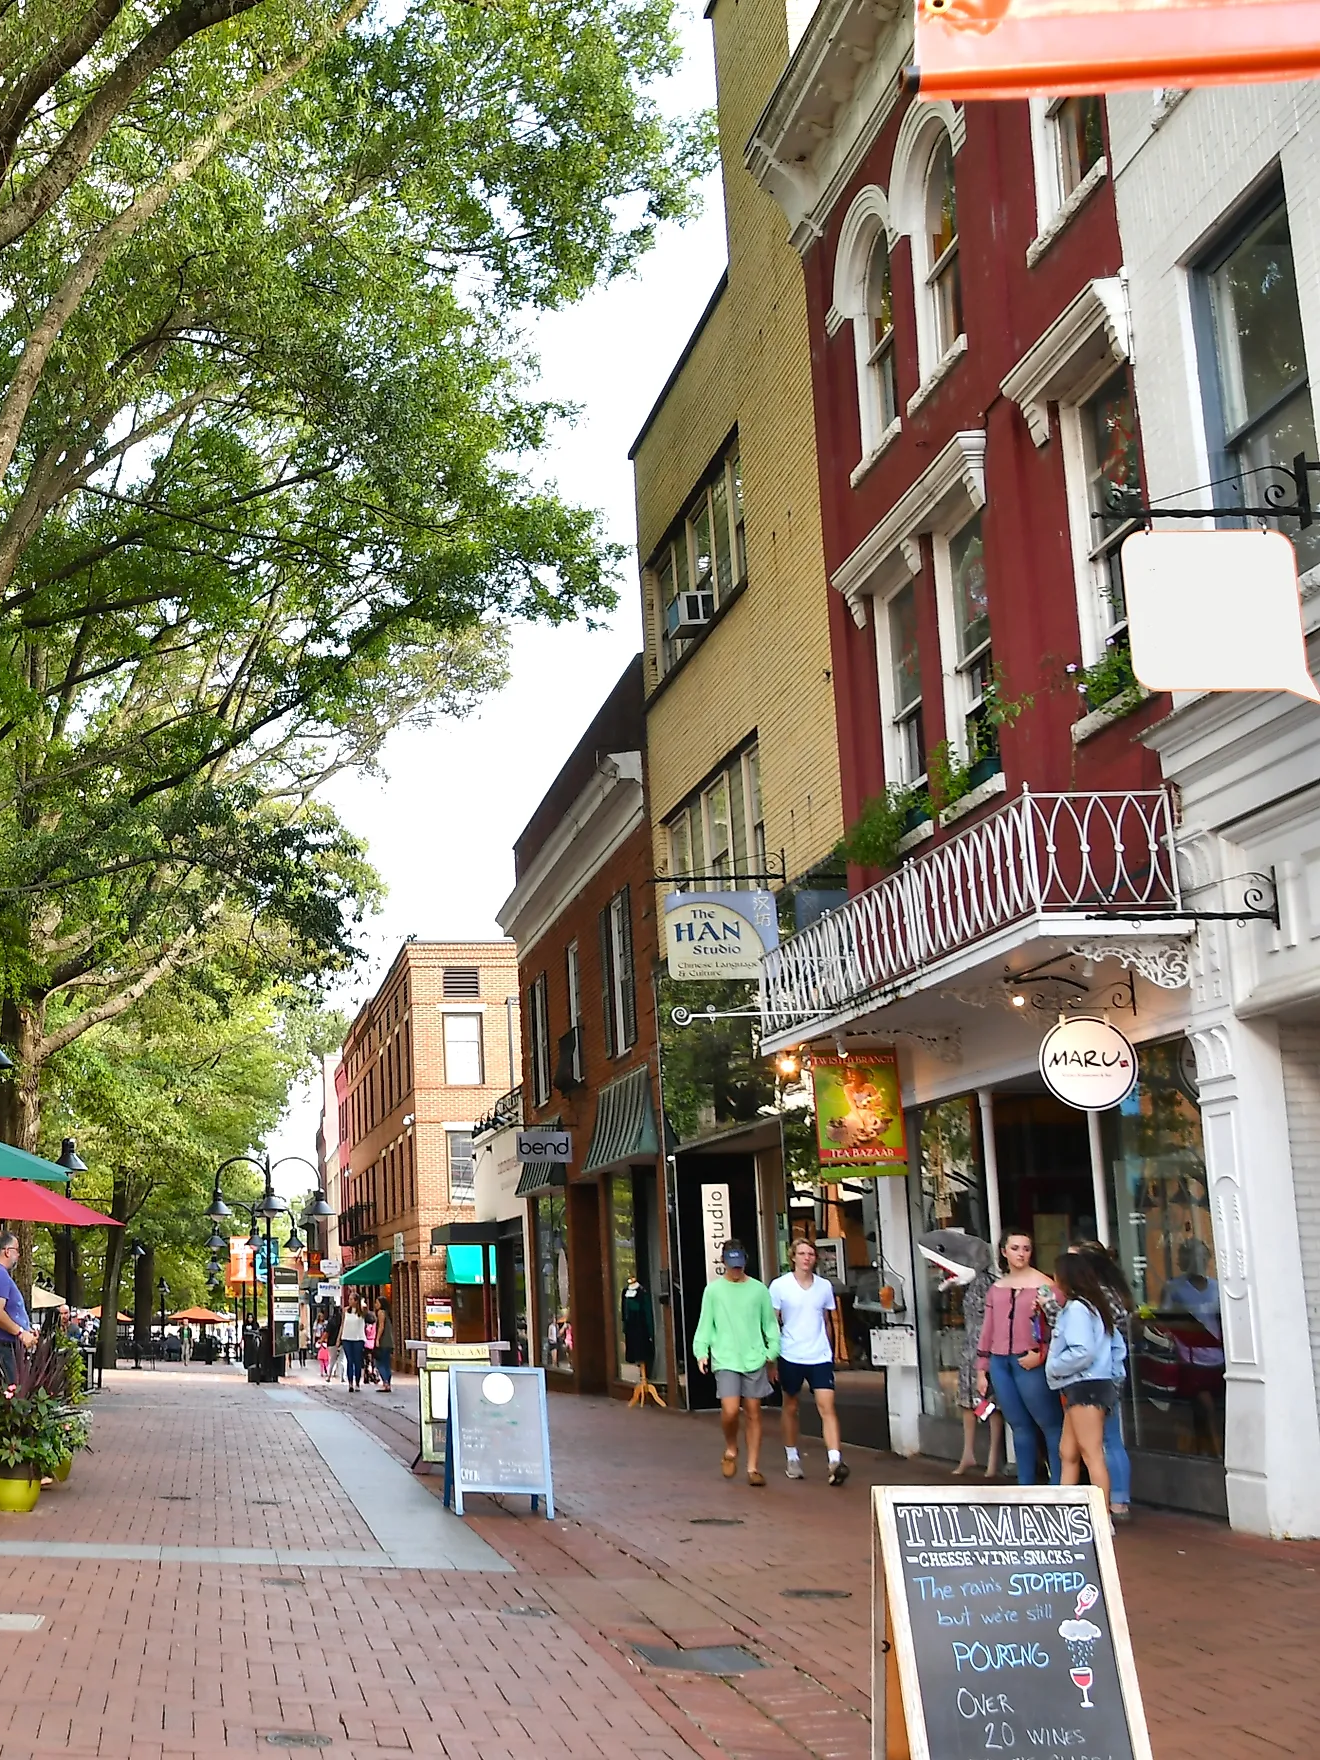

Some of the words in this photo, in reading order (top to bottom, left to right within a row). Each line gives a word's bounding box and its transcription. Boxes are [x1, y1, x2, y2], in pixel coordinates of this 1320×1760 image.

[691, 909, 715, 919] The
[673, 921, 741, 942] HAN
[692, 944, 741, 955] Studio
[1049, 1050, 1121, 1068] MARU
[519, 1137, 569, 1155] bend
[830, 1148, 850, 1158] TEA
[852, 1148, 895, 1158] BAZAAR
[707, 1190, 725, 1250] studio
[897, 1505, 1093, 1548] TILMANS
[913, 1576, 955, 1600] The
[960, 1576, 1002, 1597] rain's
[1008, 1572, 1085, 1597] STOPPED
[936, 1605, 971, 1626] but
[981, 1605, 1019, 1625] we're
[1026, 1603, 1053, 1620] still
[952, 1641, 1050, 1672] POURING
[957, 1687, 1015, 1719] OVER
[984, 1721, 1016, 1750] 20
[1026, 1727, 1086, 1747] WINES
